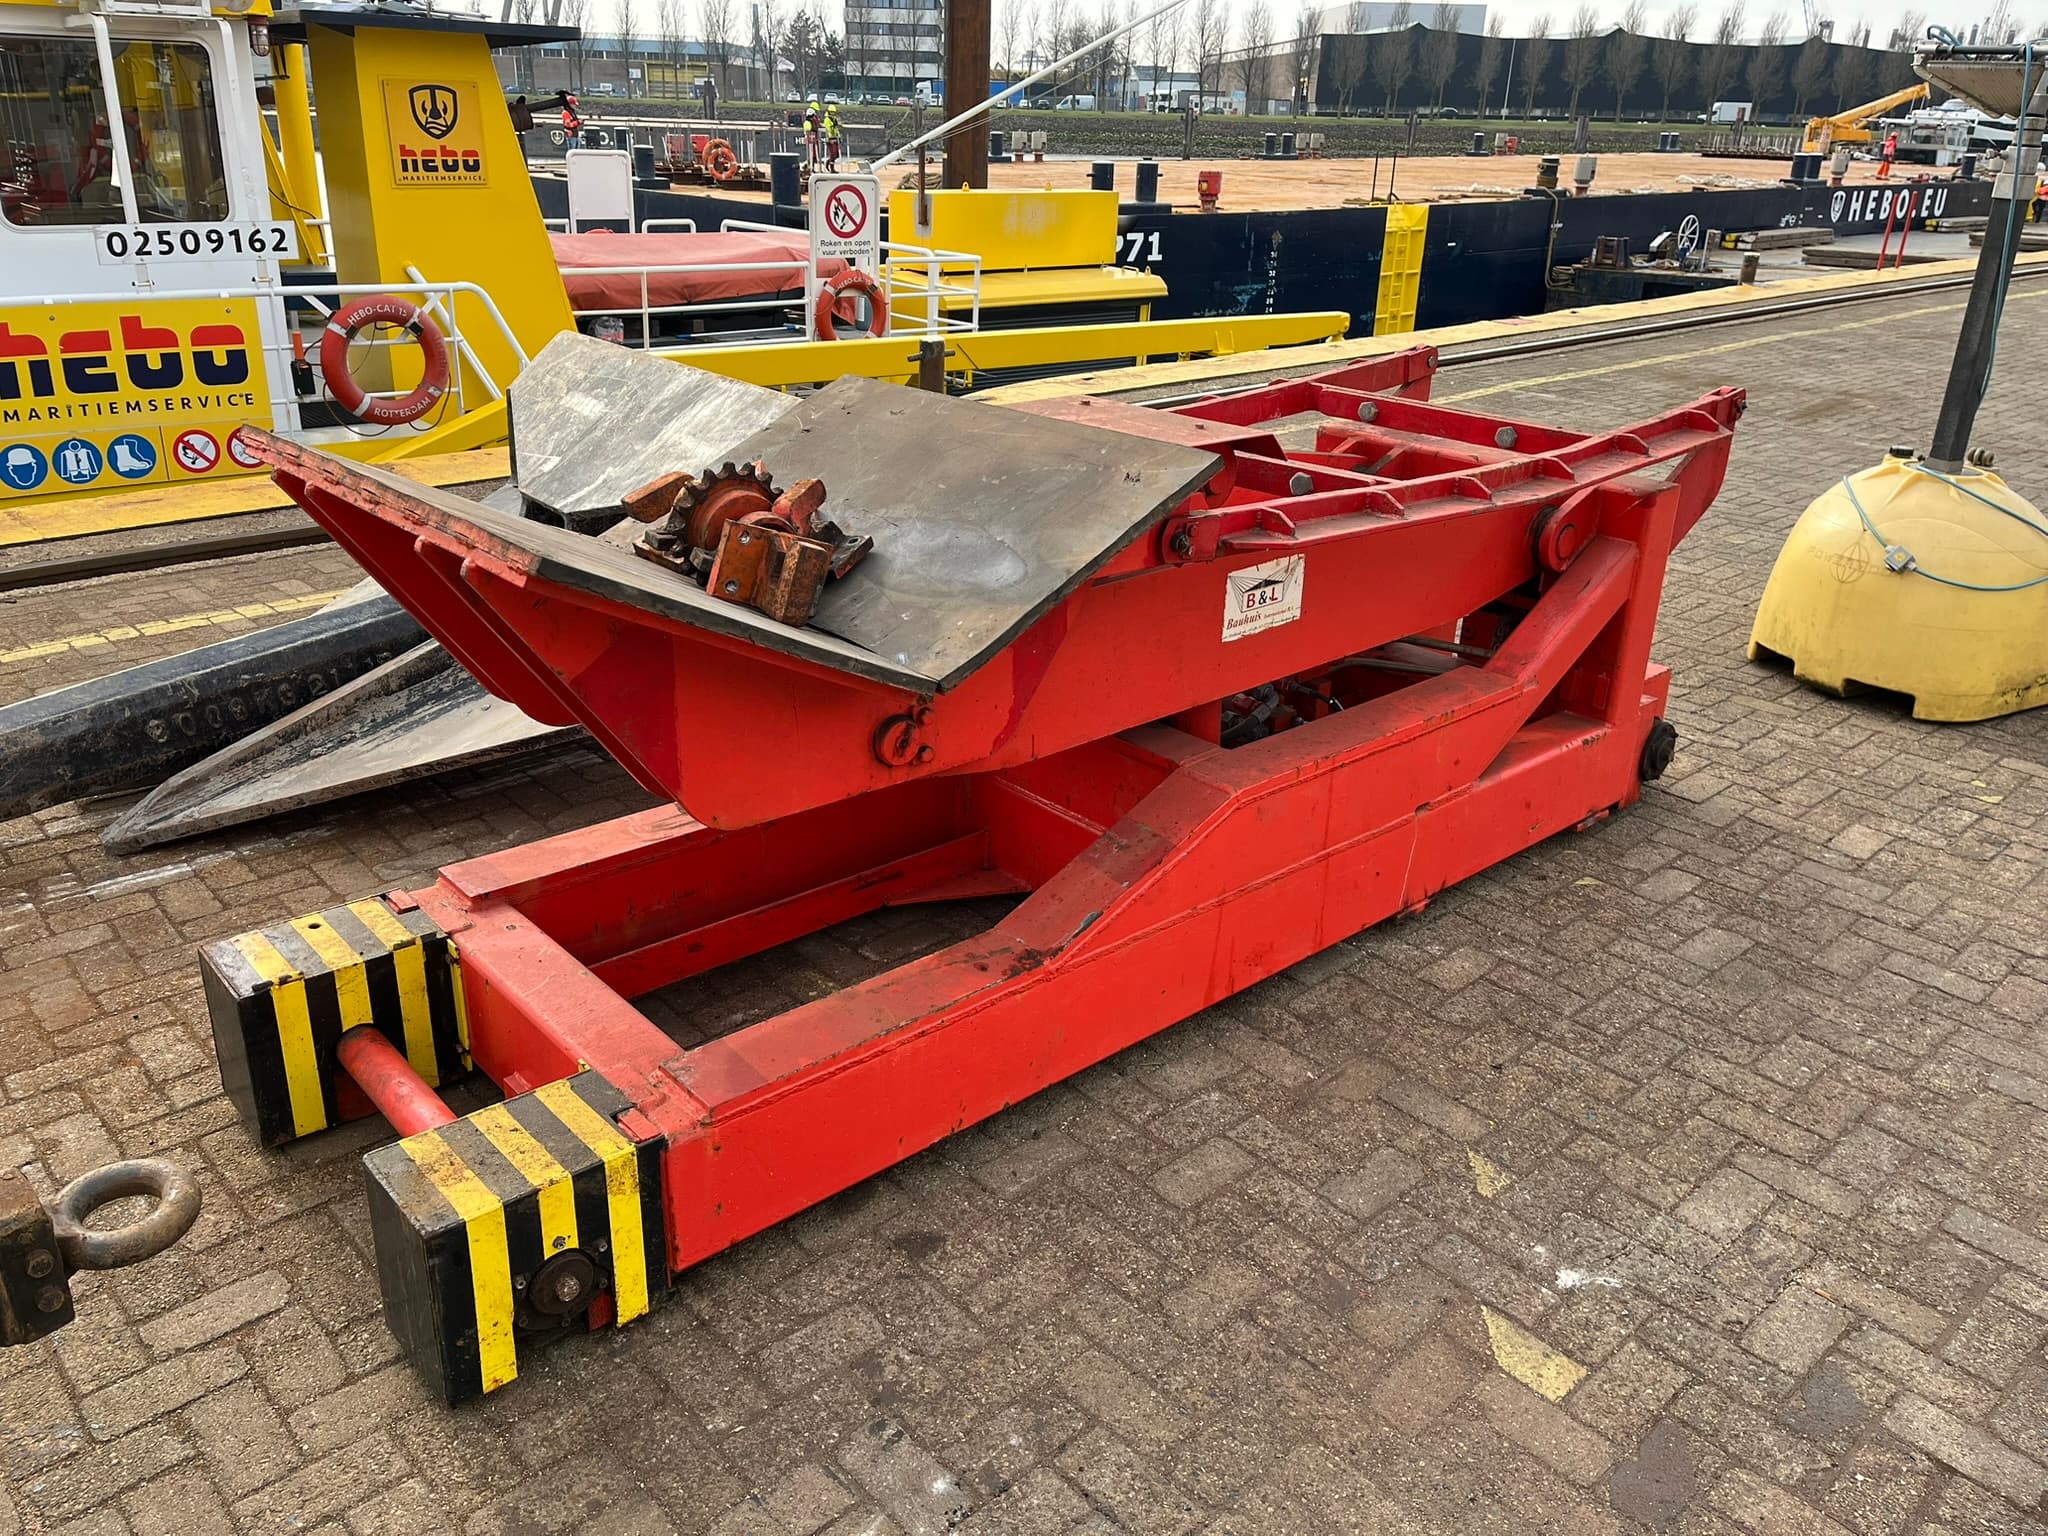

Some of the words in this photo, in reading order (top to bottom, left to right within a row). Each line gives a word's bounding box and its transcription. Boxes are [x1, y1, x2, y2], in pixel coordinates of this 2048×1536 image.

[399, 144, 481, 173] hebo
[1848, 188, 1948, 221] HEBO.EU
[106, 227, 289, 258] 02509162
[820, 239, 842, 247] Roken
[854, 240, 871, 248] open
[346, 304, 396, 326] HEBO-CAT
[0, 315, 249, 399] hebo
[3, 393, 255, 423] MARITIEMSERVICE
[374, 396, 432, 418] ROTTERDAM
[1226, 610, 1262, 631] Bauhuis
